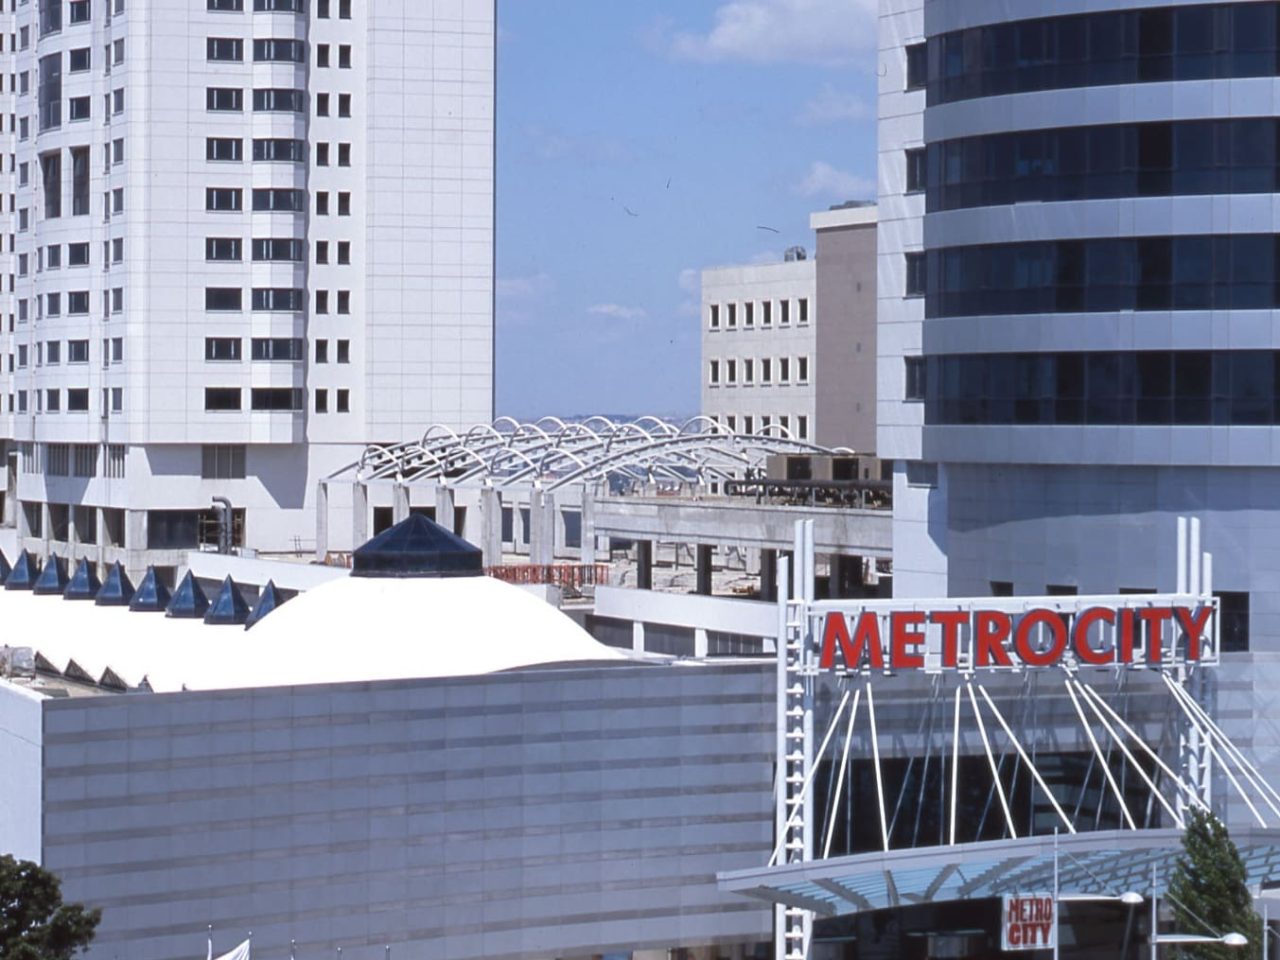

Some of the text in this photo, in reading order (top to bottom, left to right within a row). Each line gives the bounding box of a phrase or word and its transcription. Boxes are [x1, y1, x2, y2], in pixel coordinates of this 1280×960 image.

[818, 605, 1214, 670] METROCITY
[1008, 897, 1053, 922] METRO
[1008, 922, 1053, 945] CITY
